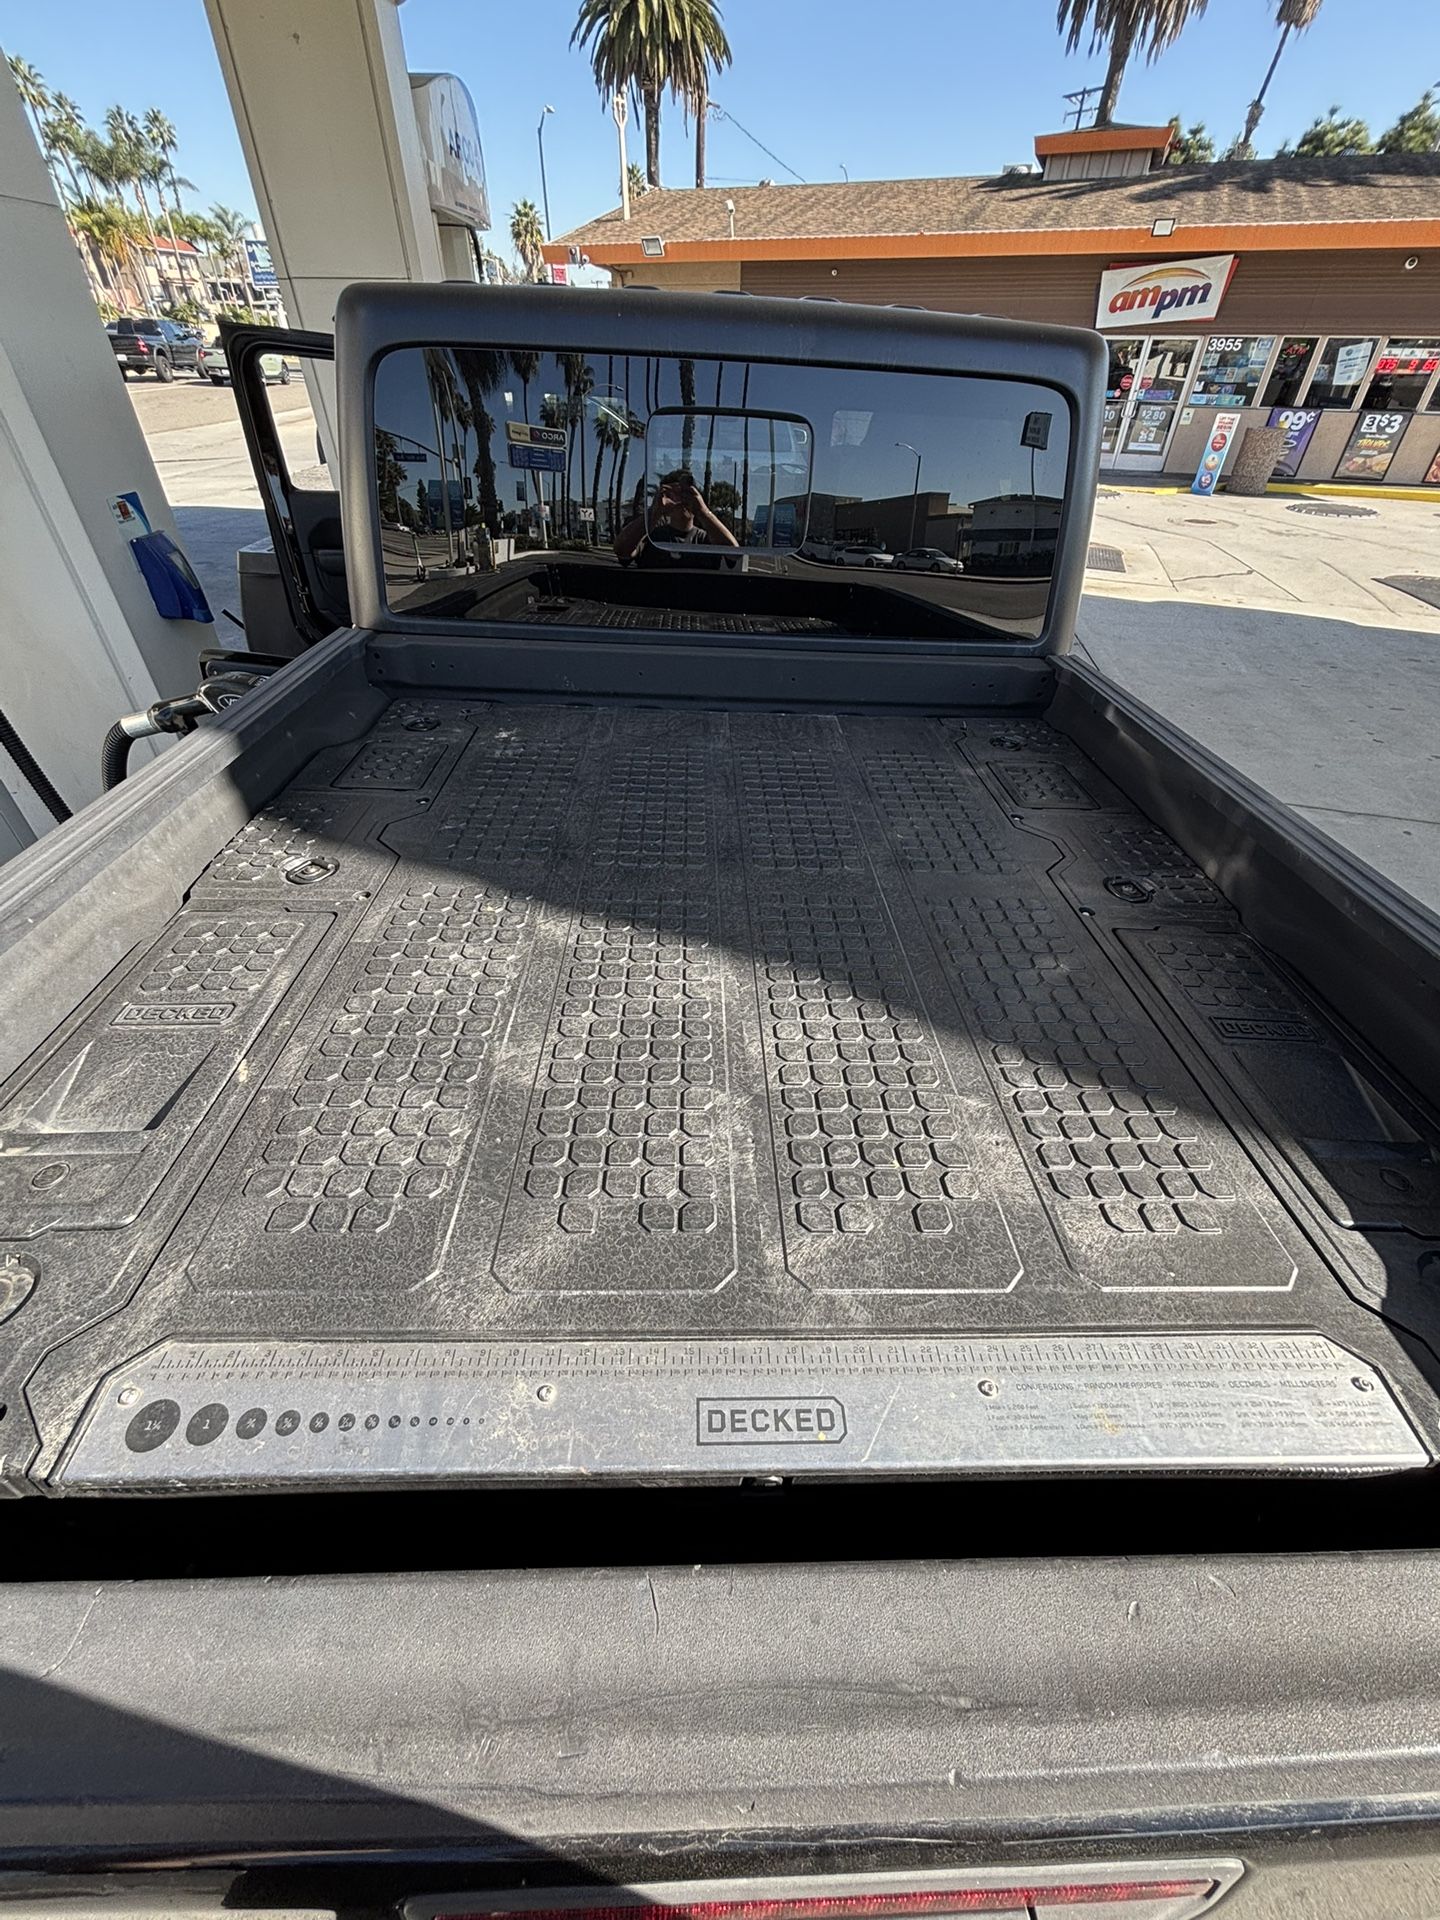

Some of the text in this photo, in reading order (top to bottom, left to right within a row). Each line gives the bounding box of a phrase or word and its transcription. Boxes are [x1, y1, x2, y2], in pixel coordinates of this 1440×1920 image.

[1108, 282, 1212, 319] ampm
[1208, 338, 1243, 351] 3955
[1286, 344, 1307, 355] ATM
[1366, 416, 1377, 427] 3
[1379, 414, 1404, 434] $3
[123, 1008, 226, 1020] DECKED
[1220, 1021, 1310, 1036] DECKED
[853, 1346, 865, 1354] 20
[1016, 1383, 1074, 1391] CONVERSIONS
[1084, 1382, 1117, 1390] RANDOM
[1118, 1381, 1163, 1390] MEASURES
[1172, 1381, 1219, 1389] FRACTIONS
[1228, 1380, 1271, 1388] DECIMALS
[707, 1408, 836, 1433] DECKED
